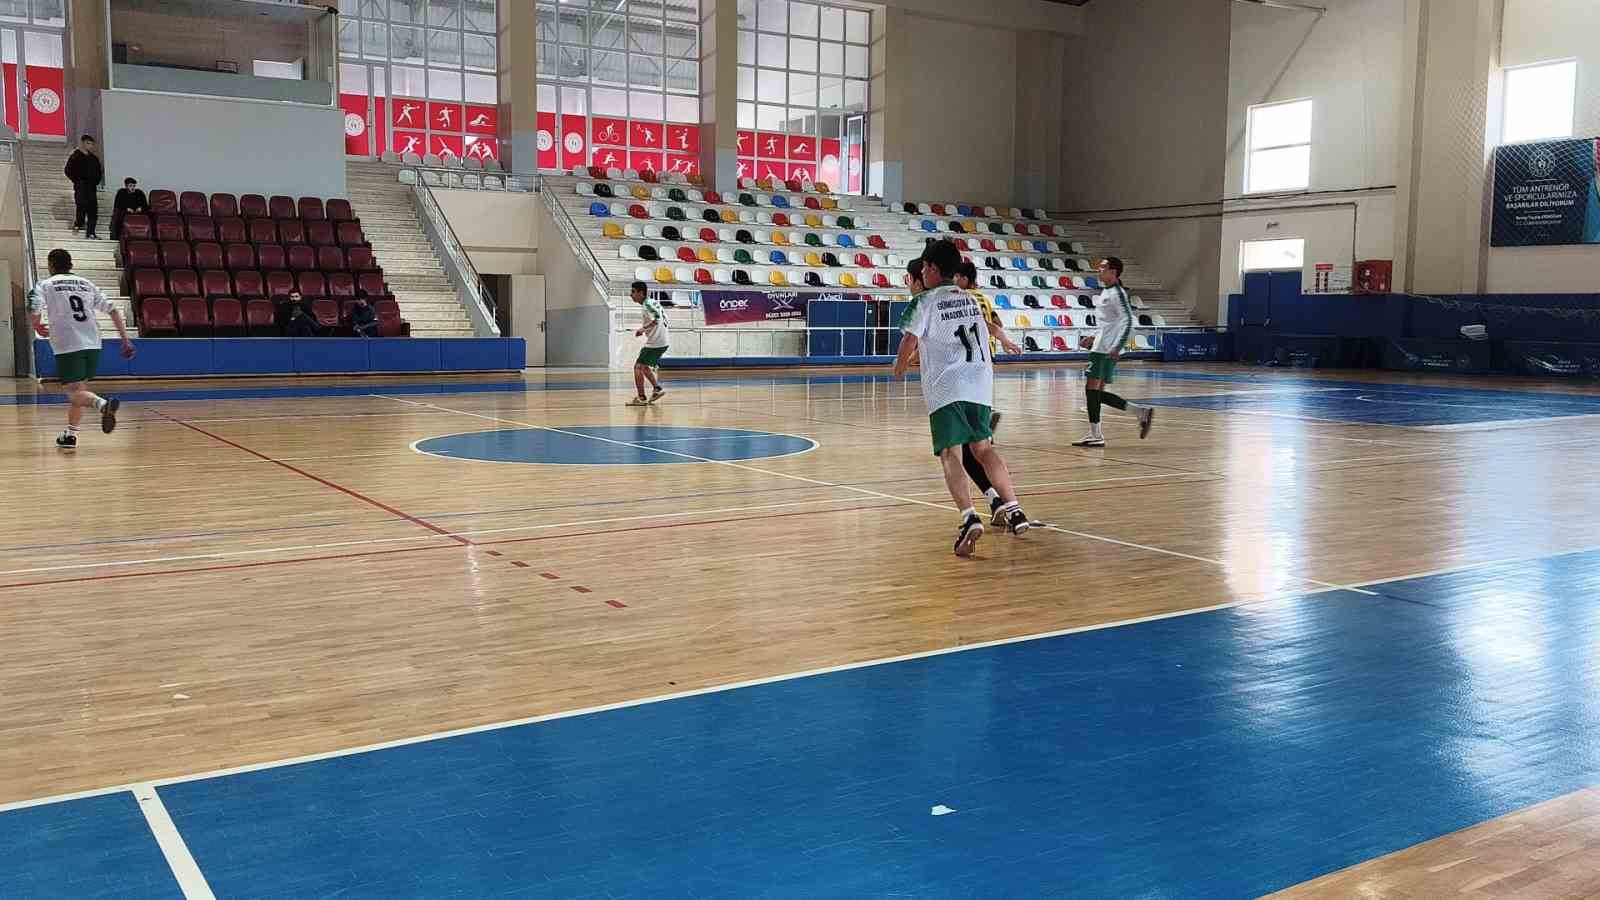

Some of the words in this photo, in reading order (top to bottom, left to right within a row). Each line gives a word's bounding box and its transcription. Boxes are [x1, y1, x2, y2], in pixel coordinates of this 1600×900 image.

[1513, 184, 1529, 193] TÜM
[69, 295, 87, 322] 9
[954, 322, 986, 362] 11
